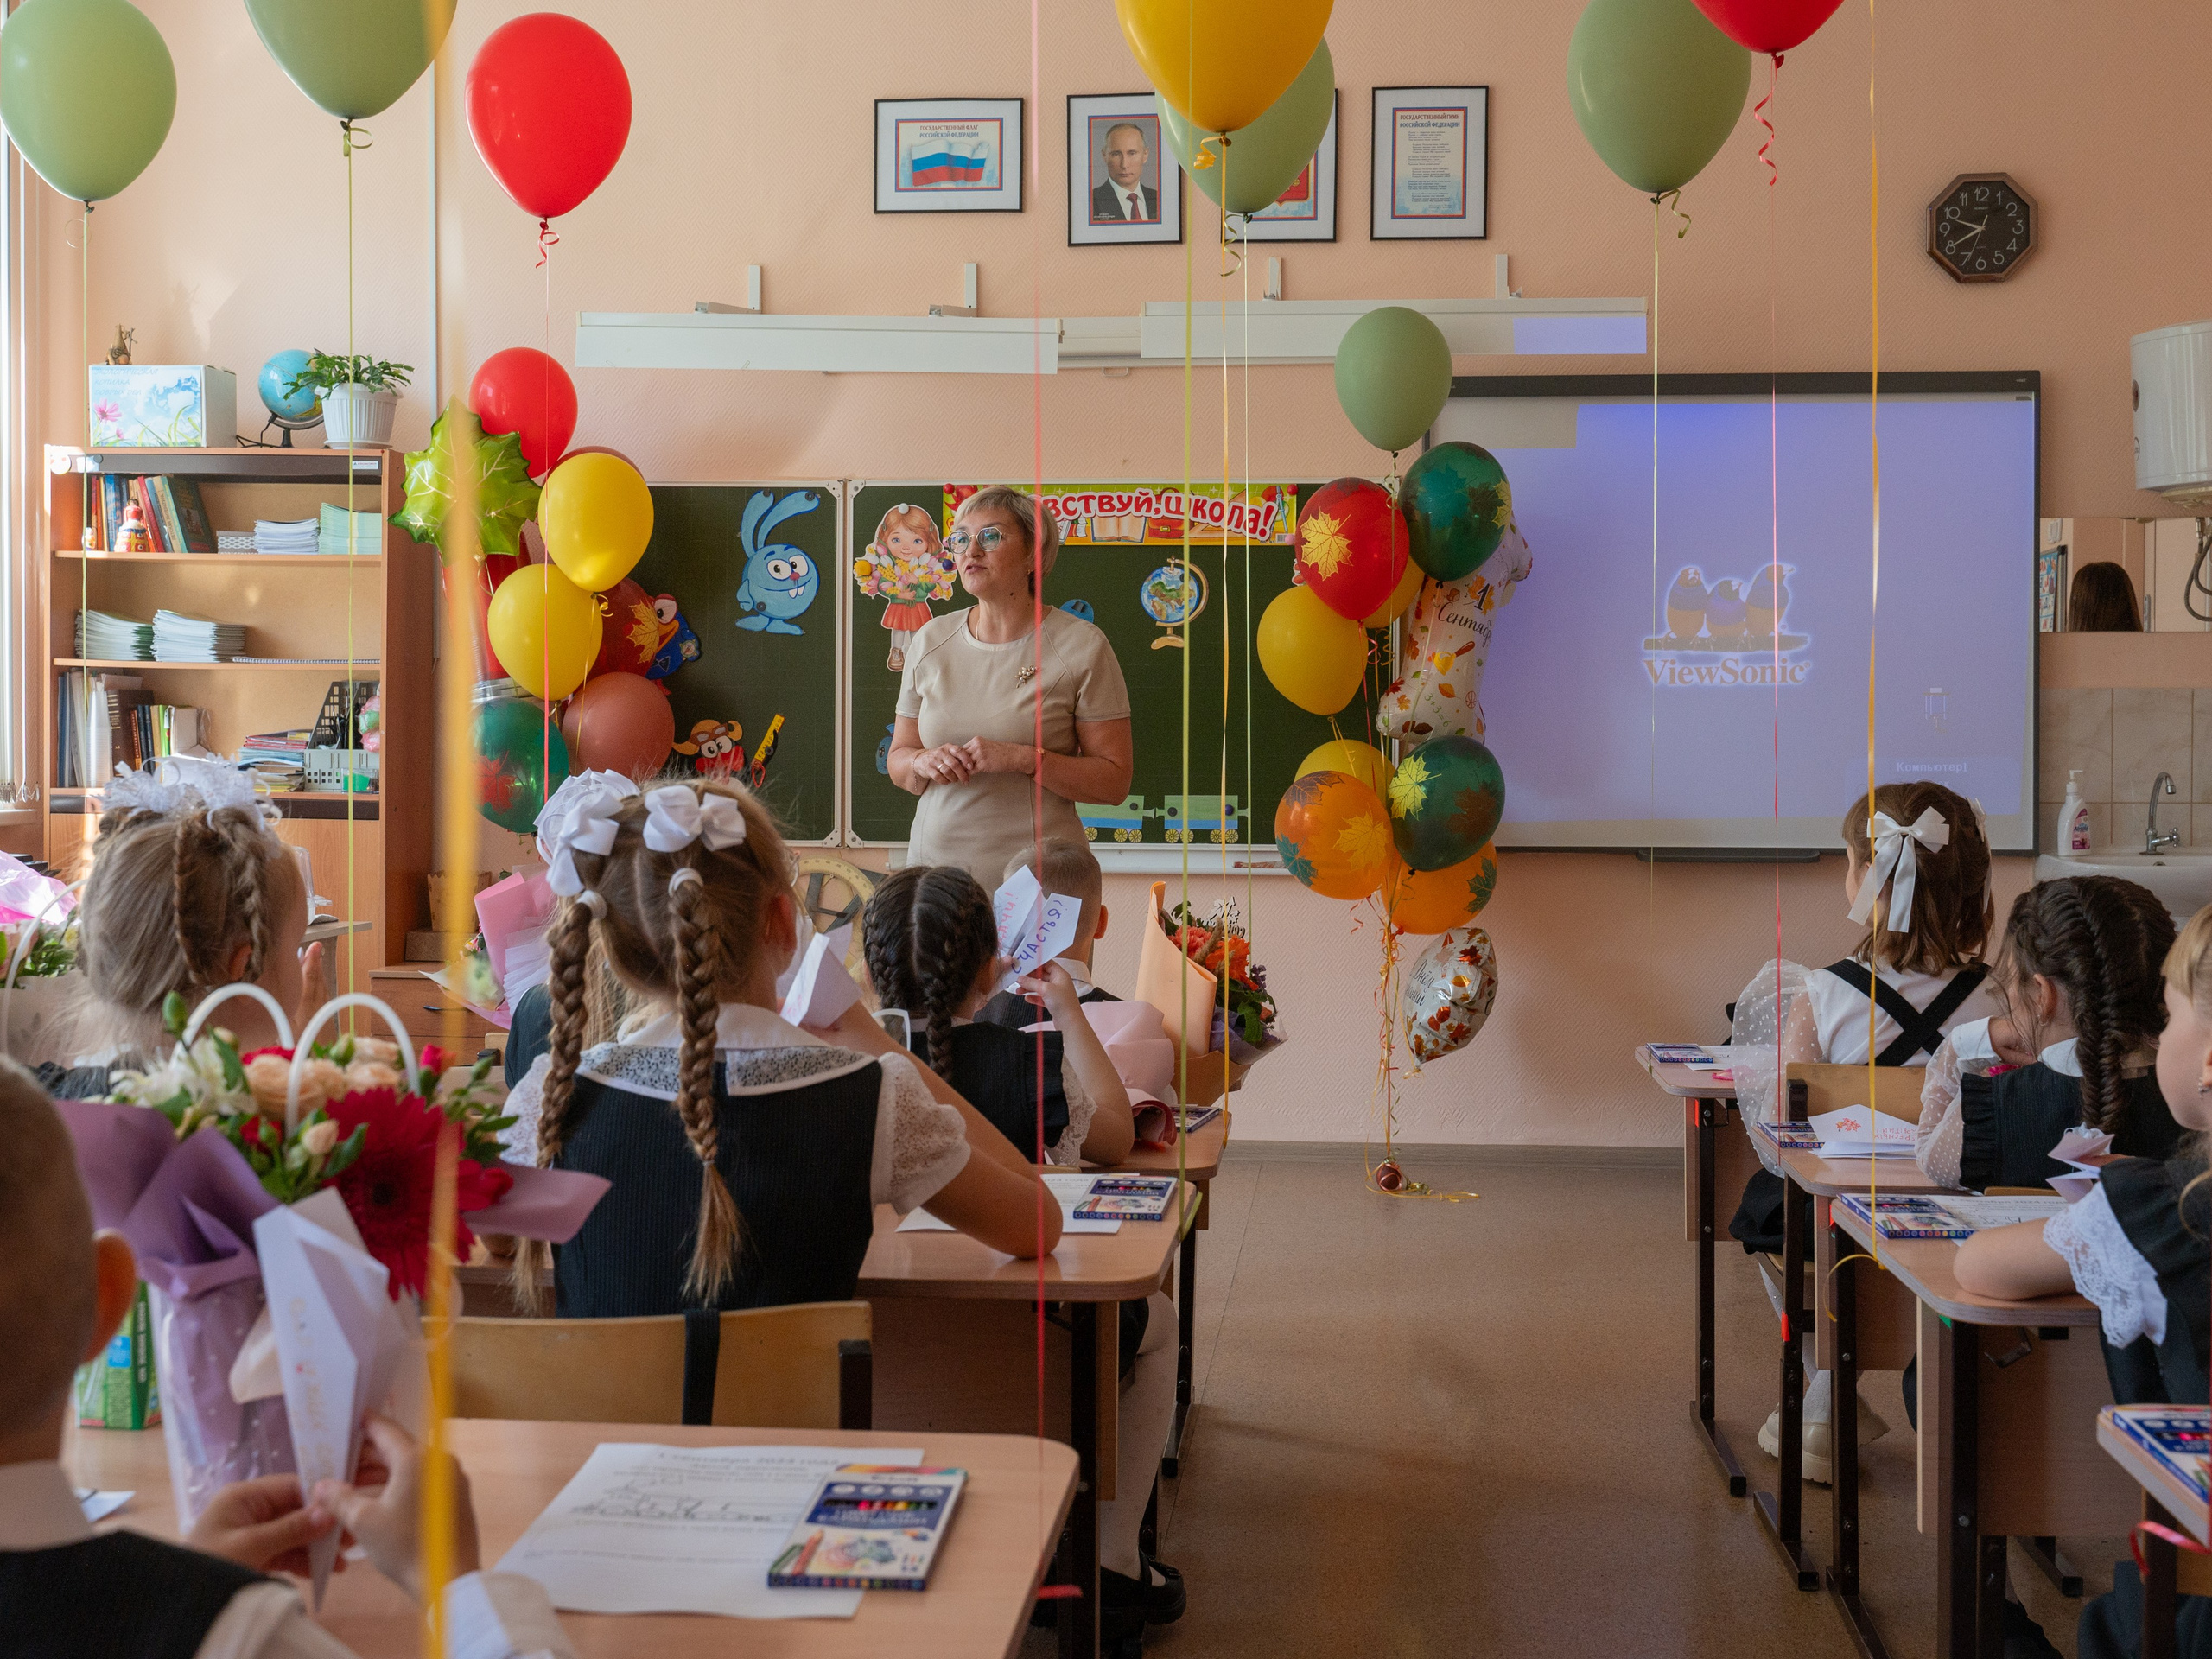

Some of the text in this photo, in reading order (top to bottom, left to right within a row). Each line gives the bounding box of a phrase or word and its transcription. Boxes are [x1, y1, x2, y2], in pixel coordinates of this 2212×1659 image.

[1960, 192, 1968, 206] 11
[1974, 187, 1990, 201] 12
[1996, 191, 2001, 205] 1
[1945, 207, 1961, 219] 10
[2006, 202, 2018, 217] 2
[1940, 222, 1950, 237] 9
[2012, 220, 2024, 235] 3
[1946, 240, 1955, 255] 8
[2006, 238, 2017, 251] 4
[1960, 252, 1971, 266] 7
[1975, 257, 1986, 270] 6
[1993, 251, 2005, 264] 5
[1473, 582, 1491, 611] 1
[1643, 658, 1805, 685] ViewSonic
[1424, 692, 1453, 728] 3+3=6
